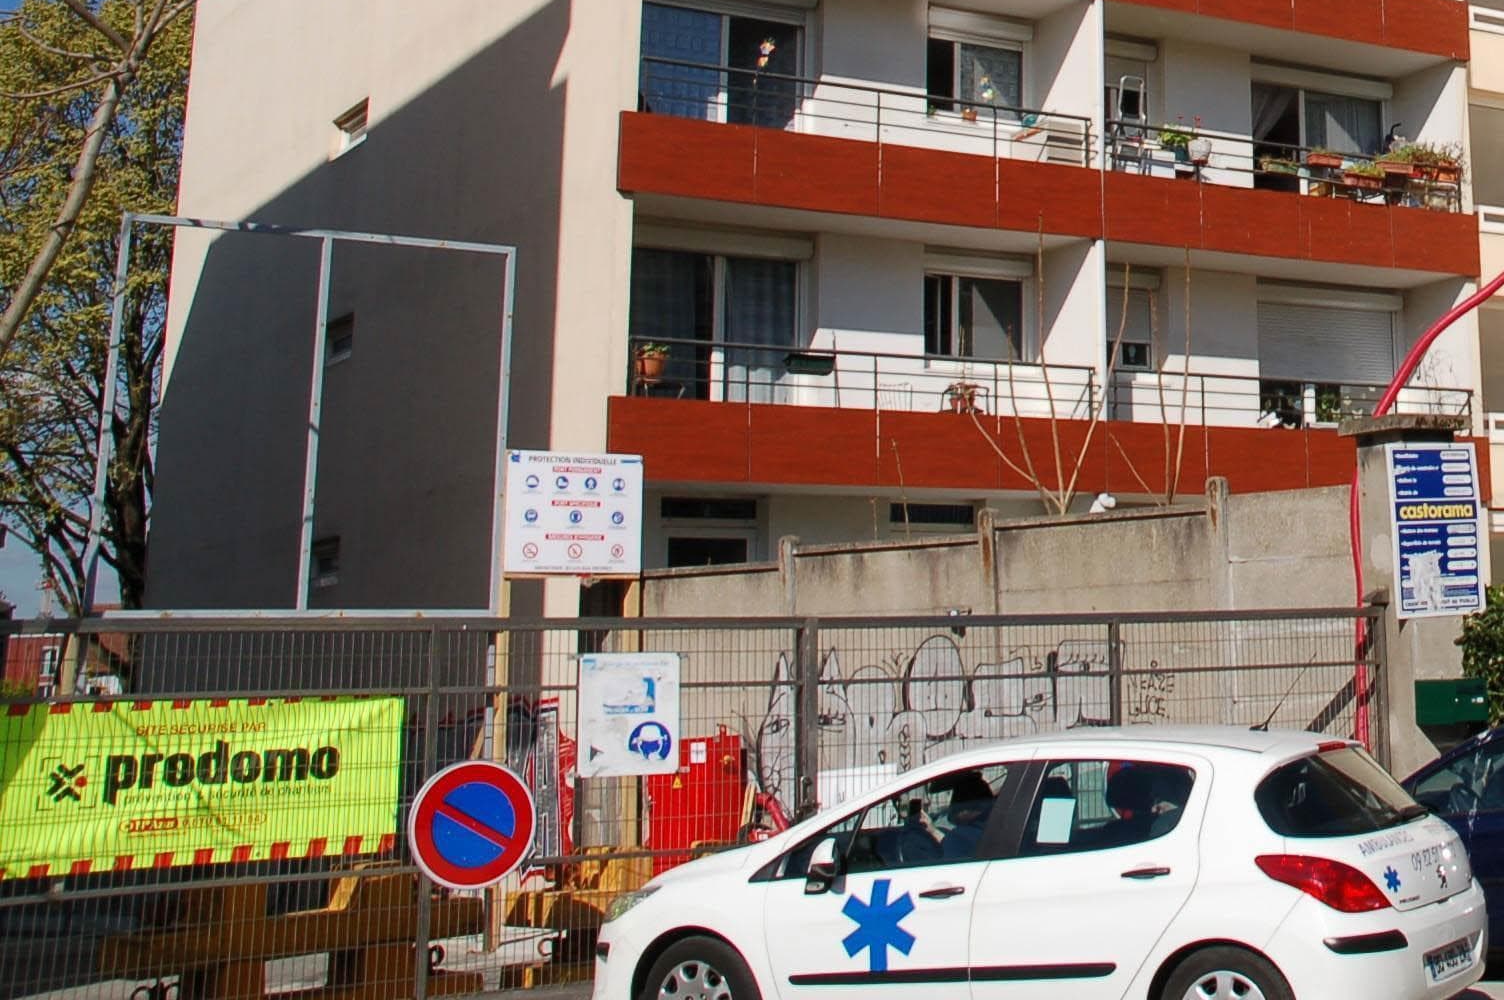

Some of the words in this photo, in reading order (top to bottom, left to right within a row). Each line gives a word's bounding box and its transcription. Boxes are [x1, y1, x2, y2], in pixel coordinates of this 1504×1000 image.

[528, 455, 571, 465] PROTECTION
[1399, 502, 1474, 520] castorama
[136, 724, 166, 737] SITE
[103, 739, 340, 807] prodomo
